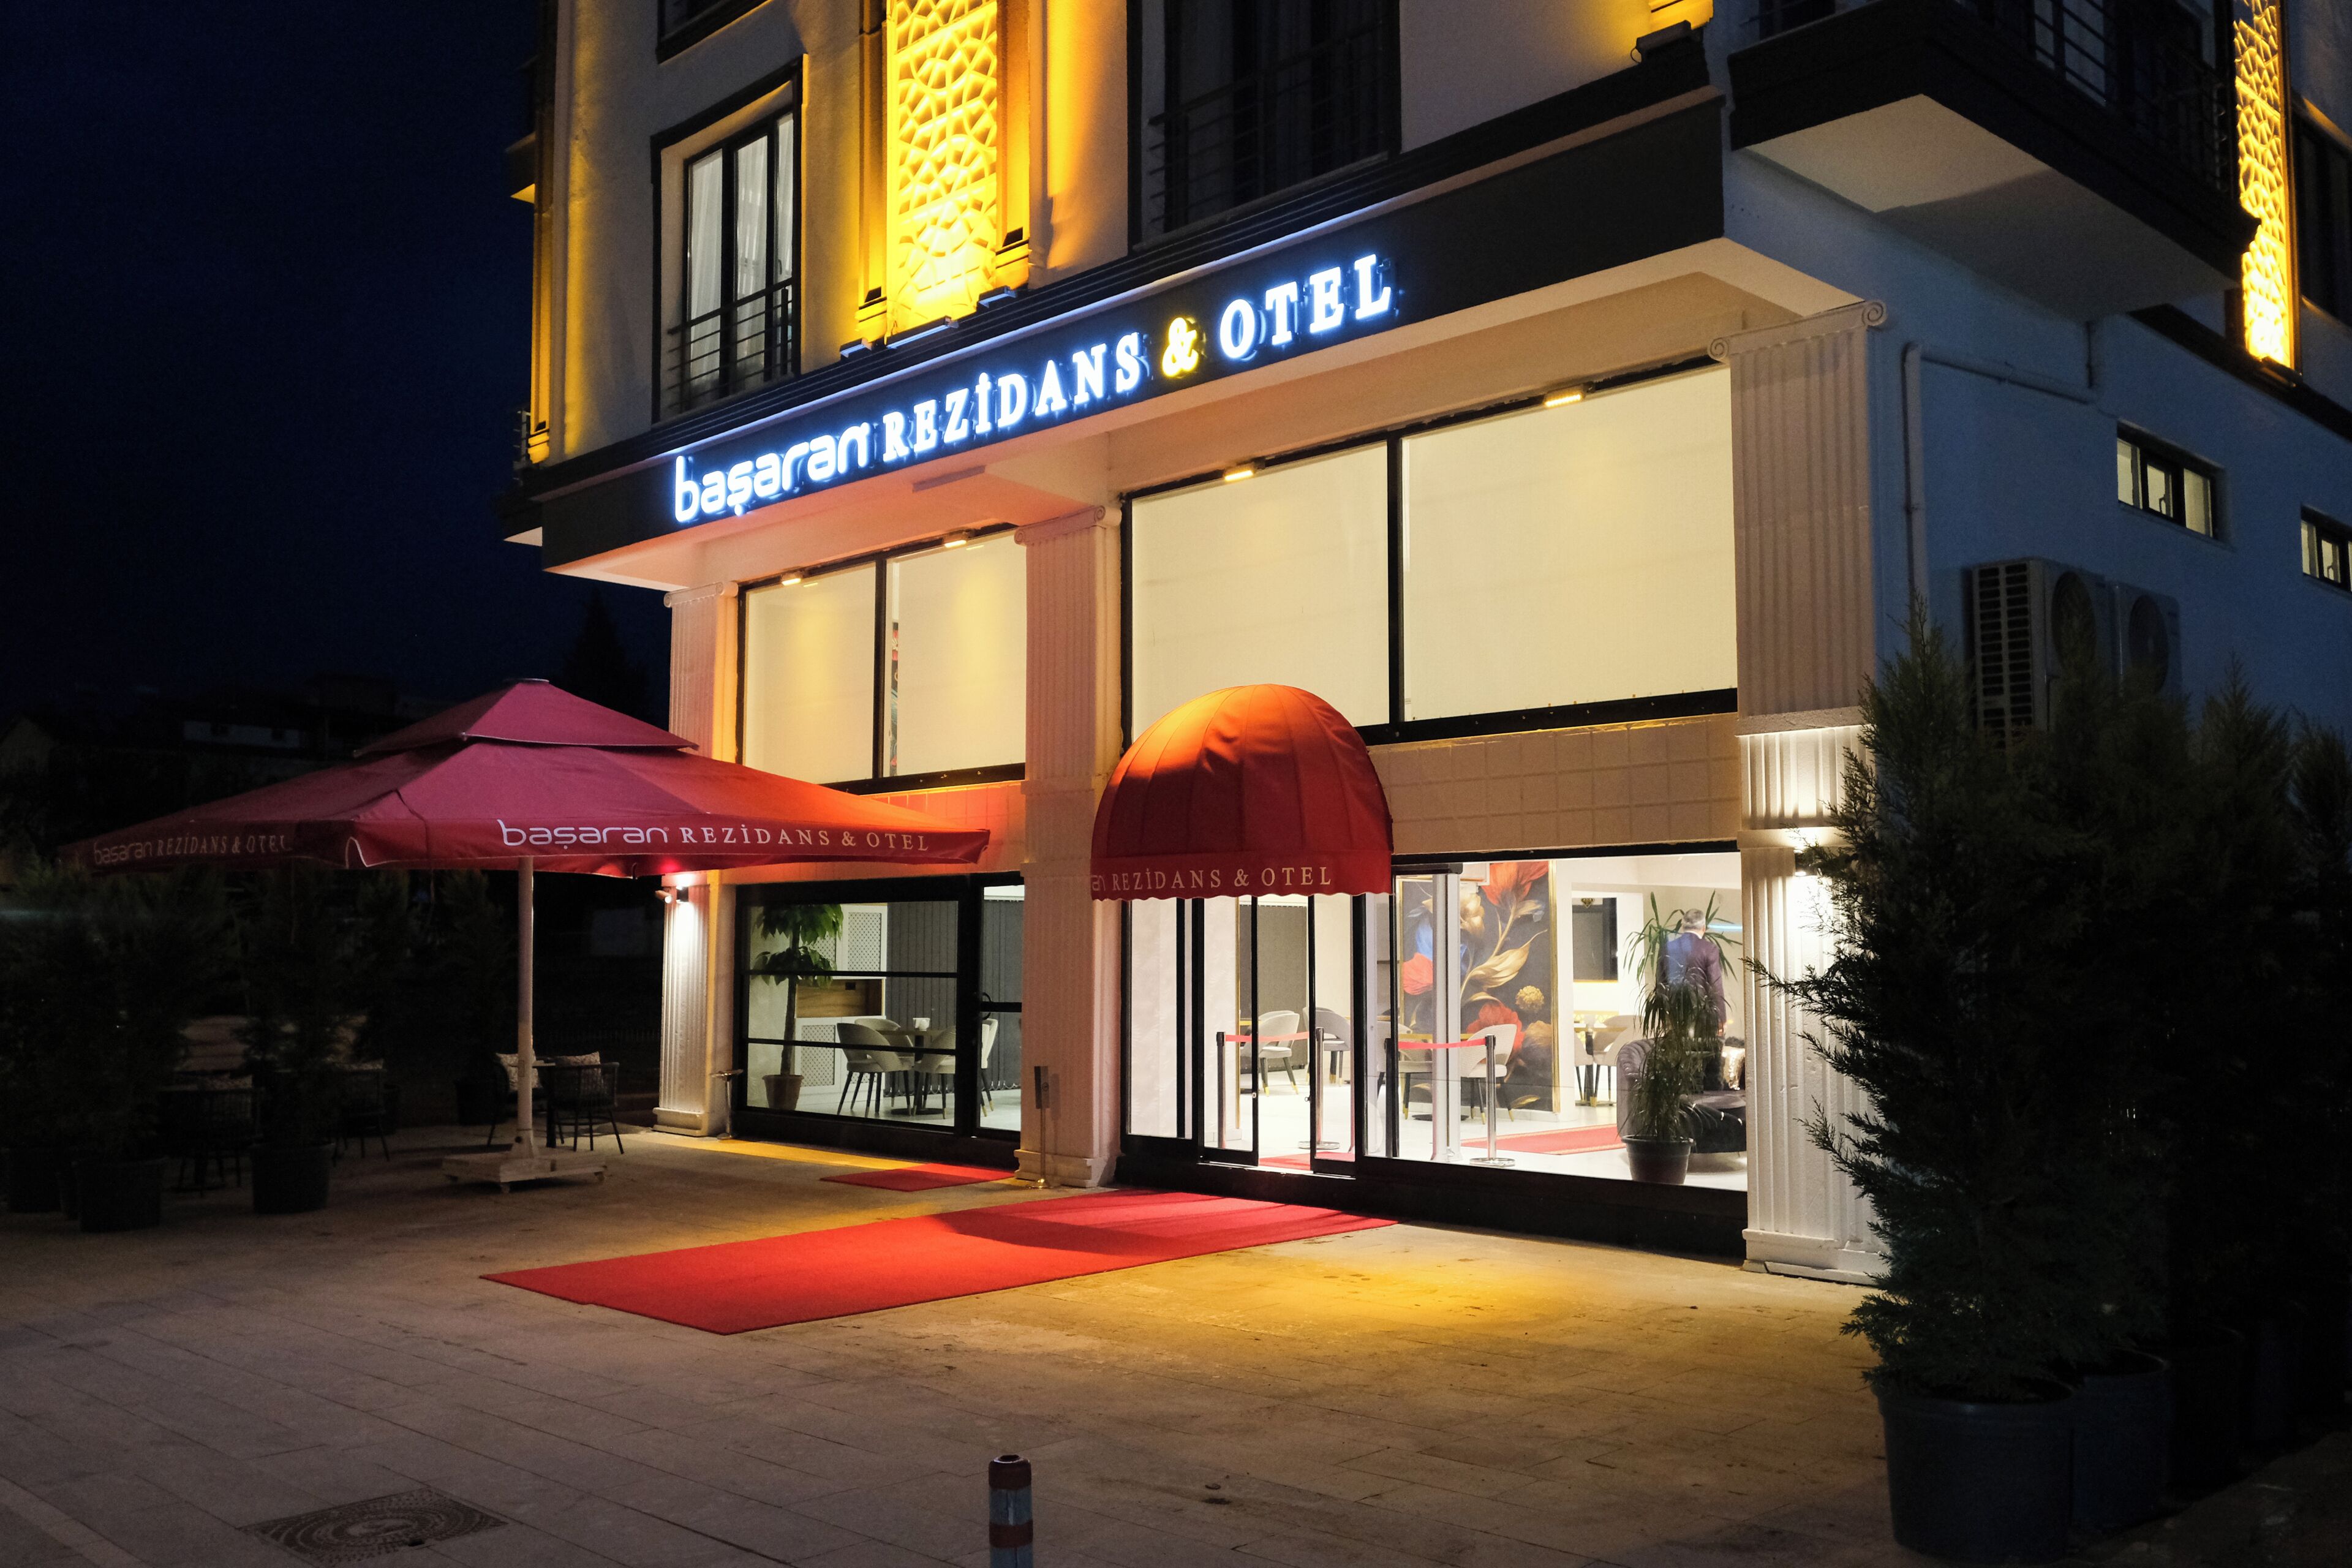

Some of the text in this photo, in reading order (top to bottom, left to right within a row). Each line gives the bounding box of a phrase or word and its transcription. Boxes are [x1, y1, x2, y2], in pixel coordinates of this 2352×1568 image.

[674, 254, 1391, 523] başaran REZİDANS & OTEL
[157, 833, 227, 856] REZİDANS
[232, 837, 241, 854] &
[497, 819, 929, 851] başaran REZİDANS & OTEL
[1112, 868, 1221, 891] REZİDANS
[1234, 869, 1250, 887] &
[1261, 867, 1331, 886] OTEL
